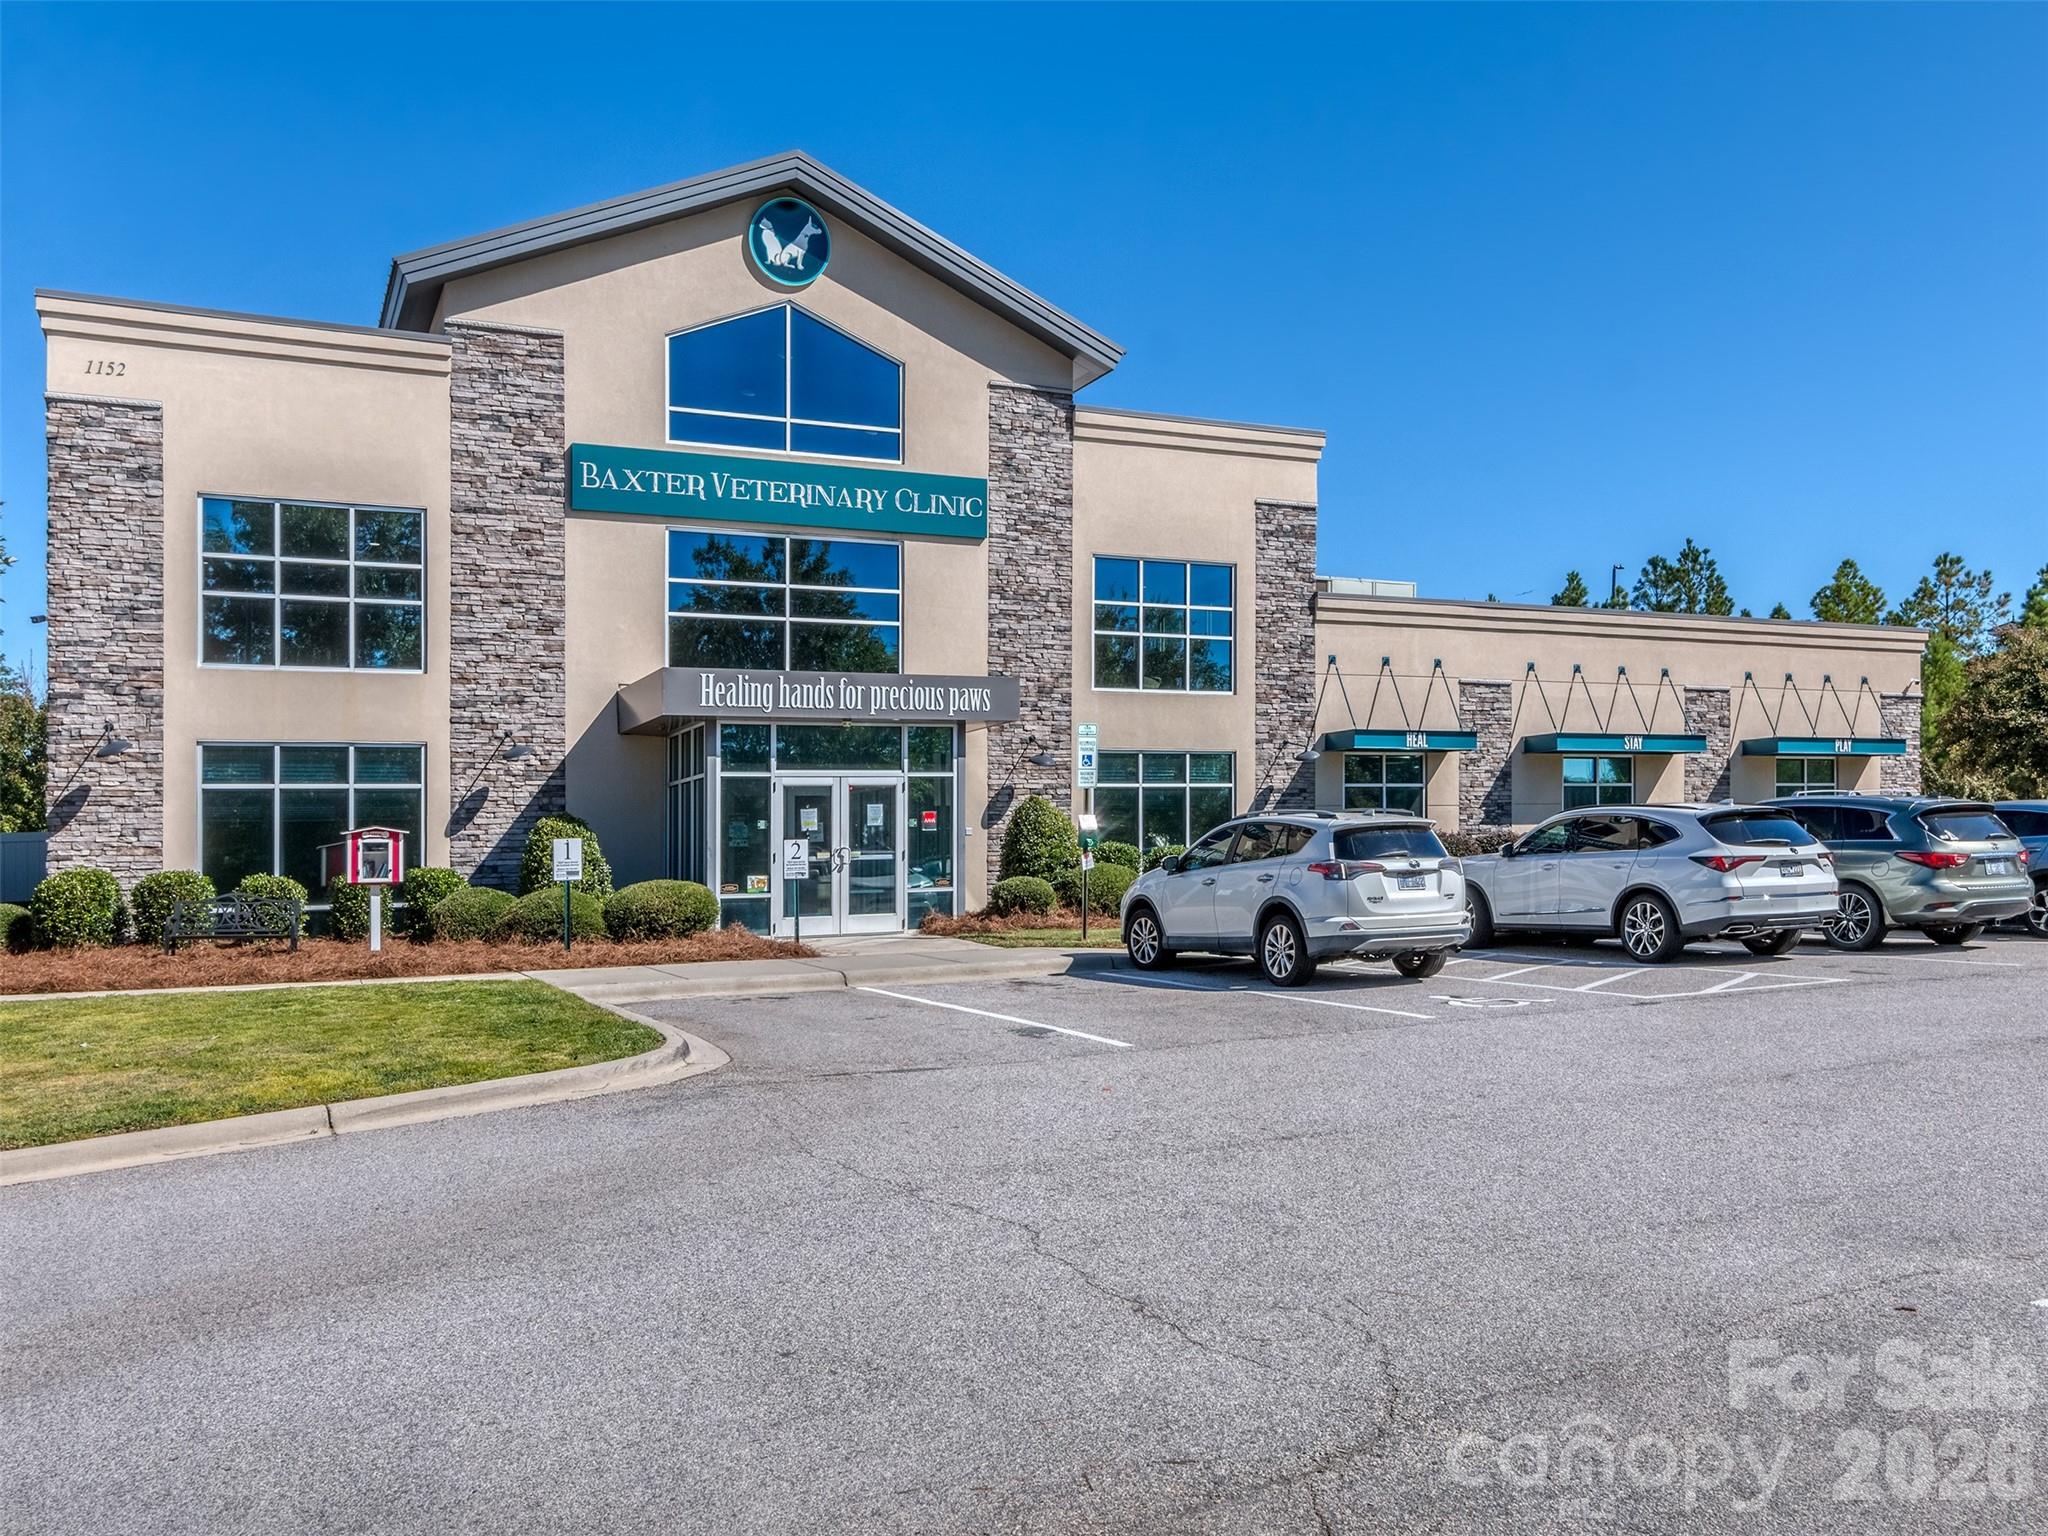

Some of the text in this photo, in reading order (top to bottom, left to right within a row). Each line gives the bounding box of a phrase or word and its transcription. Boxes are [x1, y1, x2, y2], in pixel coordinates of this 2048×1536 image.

[84, 359, 126, 377] 1152
[579, 461, 983, 518] BAXTER VETERINARY CLINIC
[699, 673, 992, 716] Healing hands for precious paws
[1406, 731, 1429, 748] HEAL
[1624, 735, 1643, 750] STAY
[1835, 739, 1852, 753] PLAY
[564, 841, 571, 860] 1
[790, 842, 802, 860] 2
